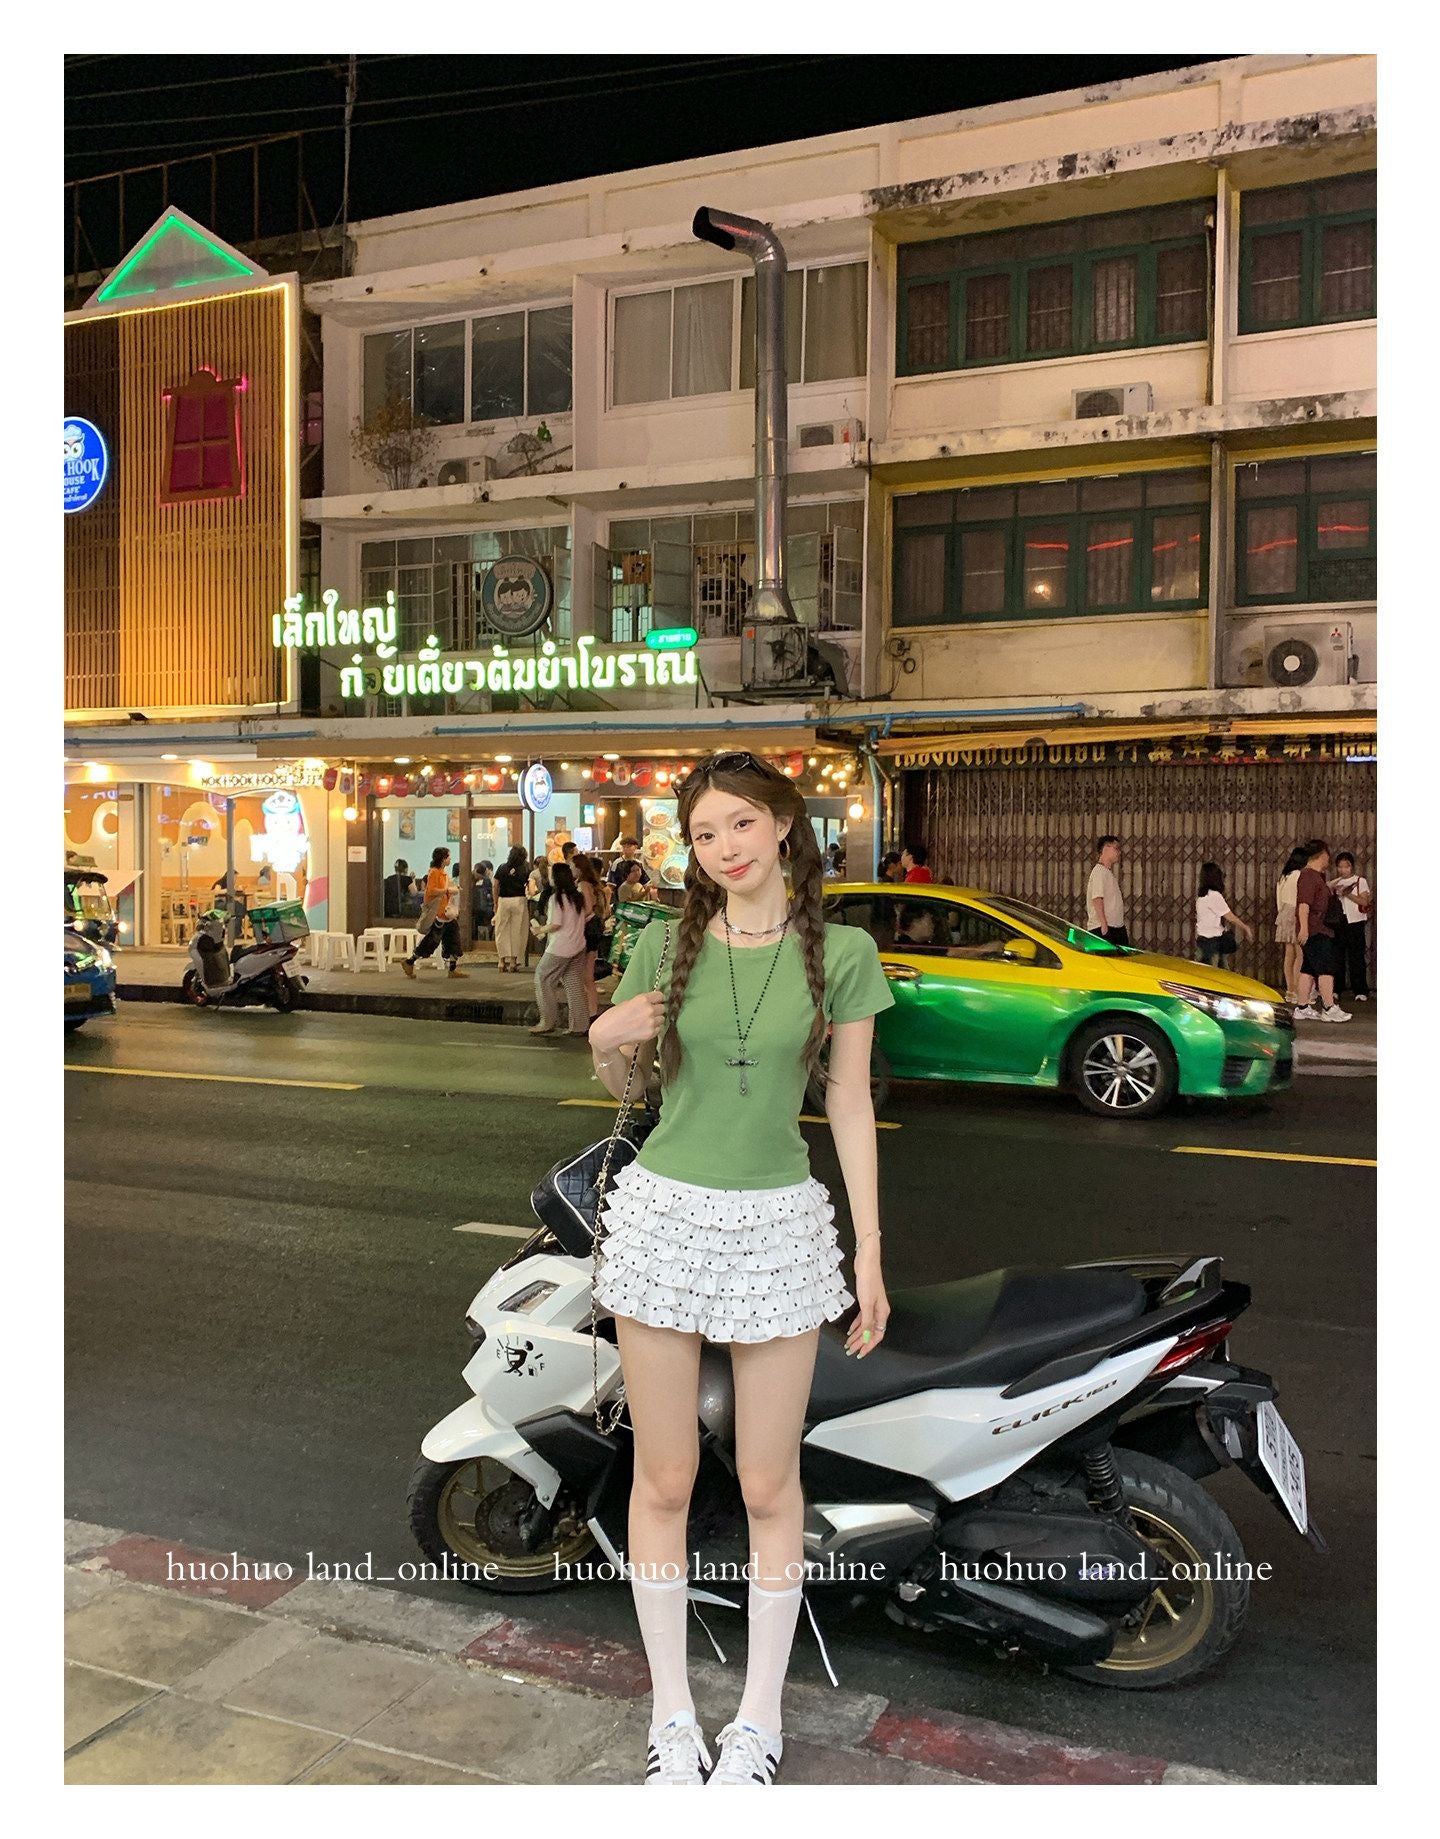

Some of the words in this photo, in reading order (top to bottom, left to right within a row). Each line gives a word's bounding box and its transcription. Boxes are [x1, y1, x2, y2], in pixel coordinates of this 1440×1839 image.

[64, 475, 86, 486] OUSE
[272, 588, 399, 659] เล็กใหญ่
